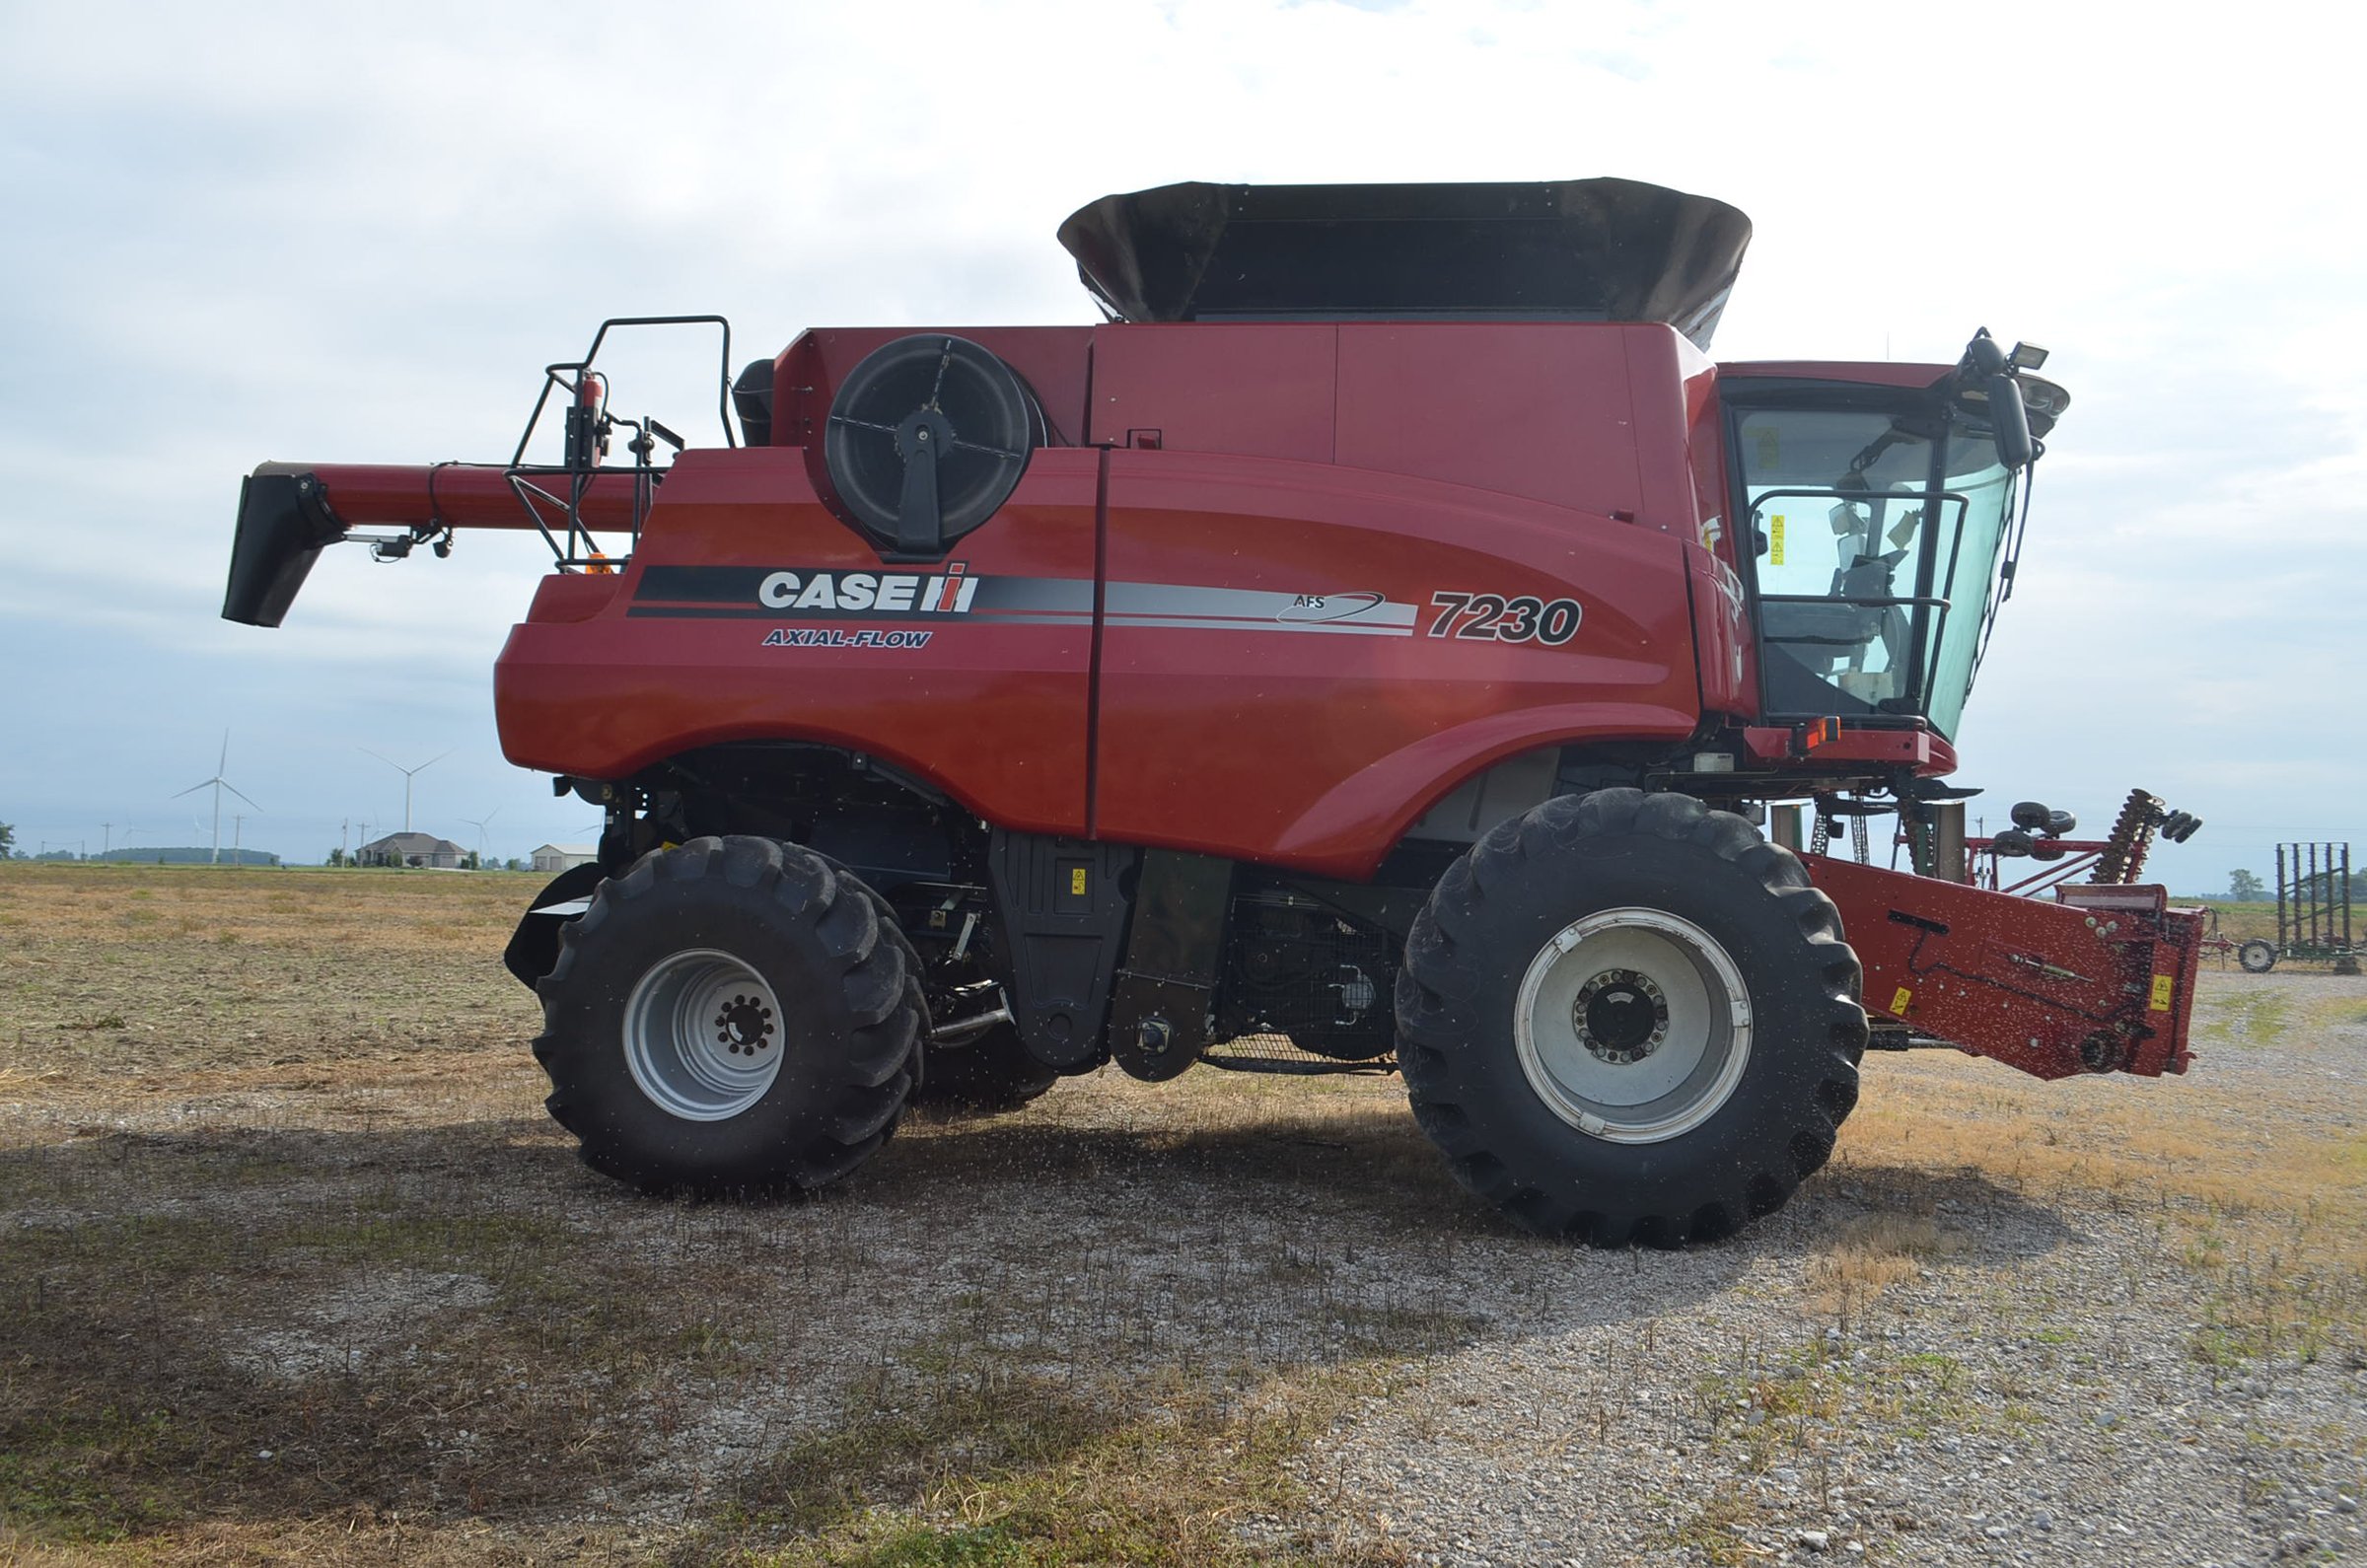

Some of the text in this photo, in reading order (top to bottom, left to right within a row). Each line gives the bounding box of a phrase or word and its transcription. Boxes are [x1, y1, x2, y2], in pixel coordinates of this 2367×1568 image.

[758, 571, 919, 610] CASE
[1293, 595, 1326, 608] AFS
[1427, 591, 1582, 645] 7230
[761, 628, 933, 649] AXIAL-FLOW
